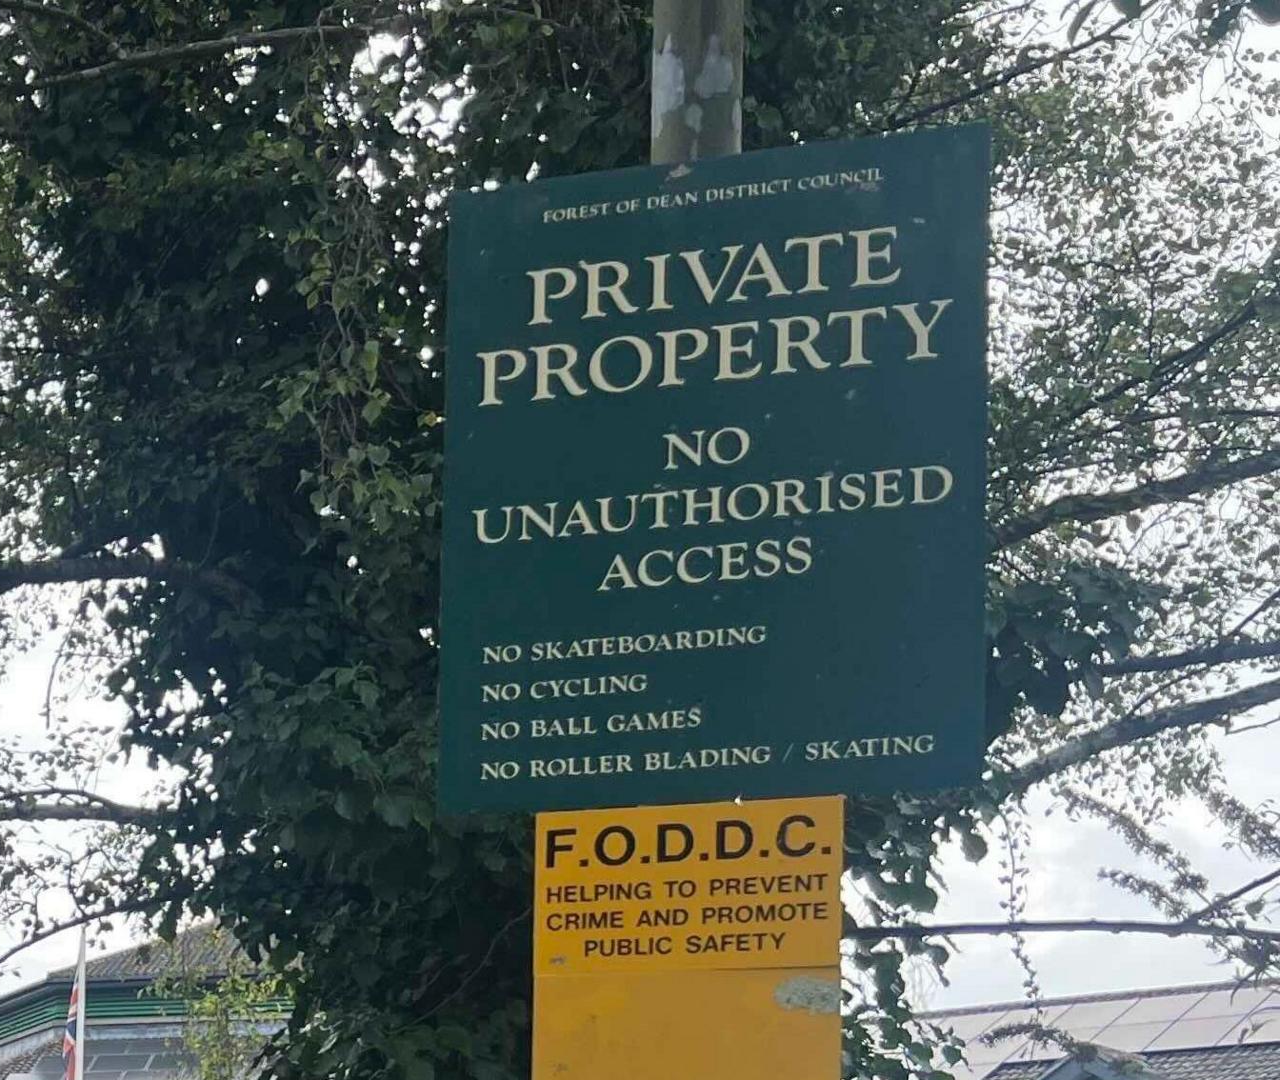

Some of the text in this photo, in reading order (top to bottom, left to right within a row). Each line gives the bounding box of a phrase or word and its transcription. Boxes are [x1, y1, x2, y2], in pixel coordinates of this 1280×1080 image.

[543, 168, 884, 223] FOREST OF DEAN DISTRICT COUNCIL
[526, 226, 902, 326] PRIVATE
[477, 299, 953, 407] PROPERTY
[663, 427, 750, 469] NO
[473, 465, 953, 544] UNAUTHORISED
[597, 537, 812, 591] ACCESS
[483, 626, 767, 664] NO SKATEBOARDING
[482, 674, 647, 702] NO CYCLING
[481, 707, 701, 741] NO BALL GAMES
[480, 761, 519, 780] NO
[530, 755, 633, 778] ROLLER
[645, 746, 771, 772] BLADING
[805, 735, 935, 761] SKATING
[546, 815, 831, 869] F.O.D.D.C.
[547, 873, 828, 903] HELPING TO PREVENT
[547, 902, 828, 931] CRIME AND PROMOTE
[585, 932, 786, 957] PUBLIC SAFETY
